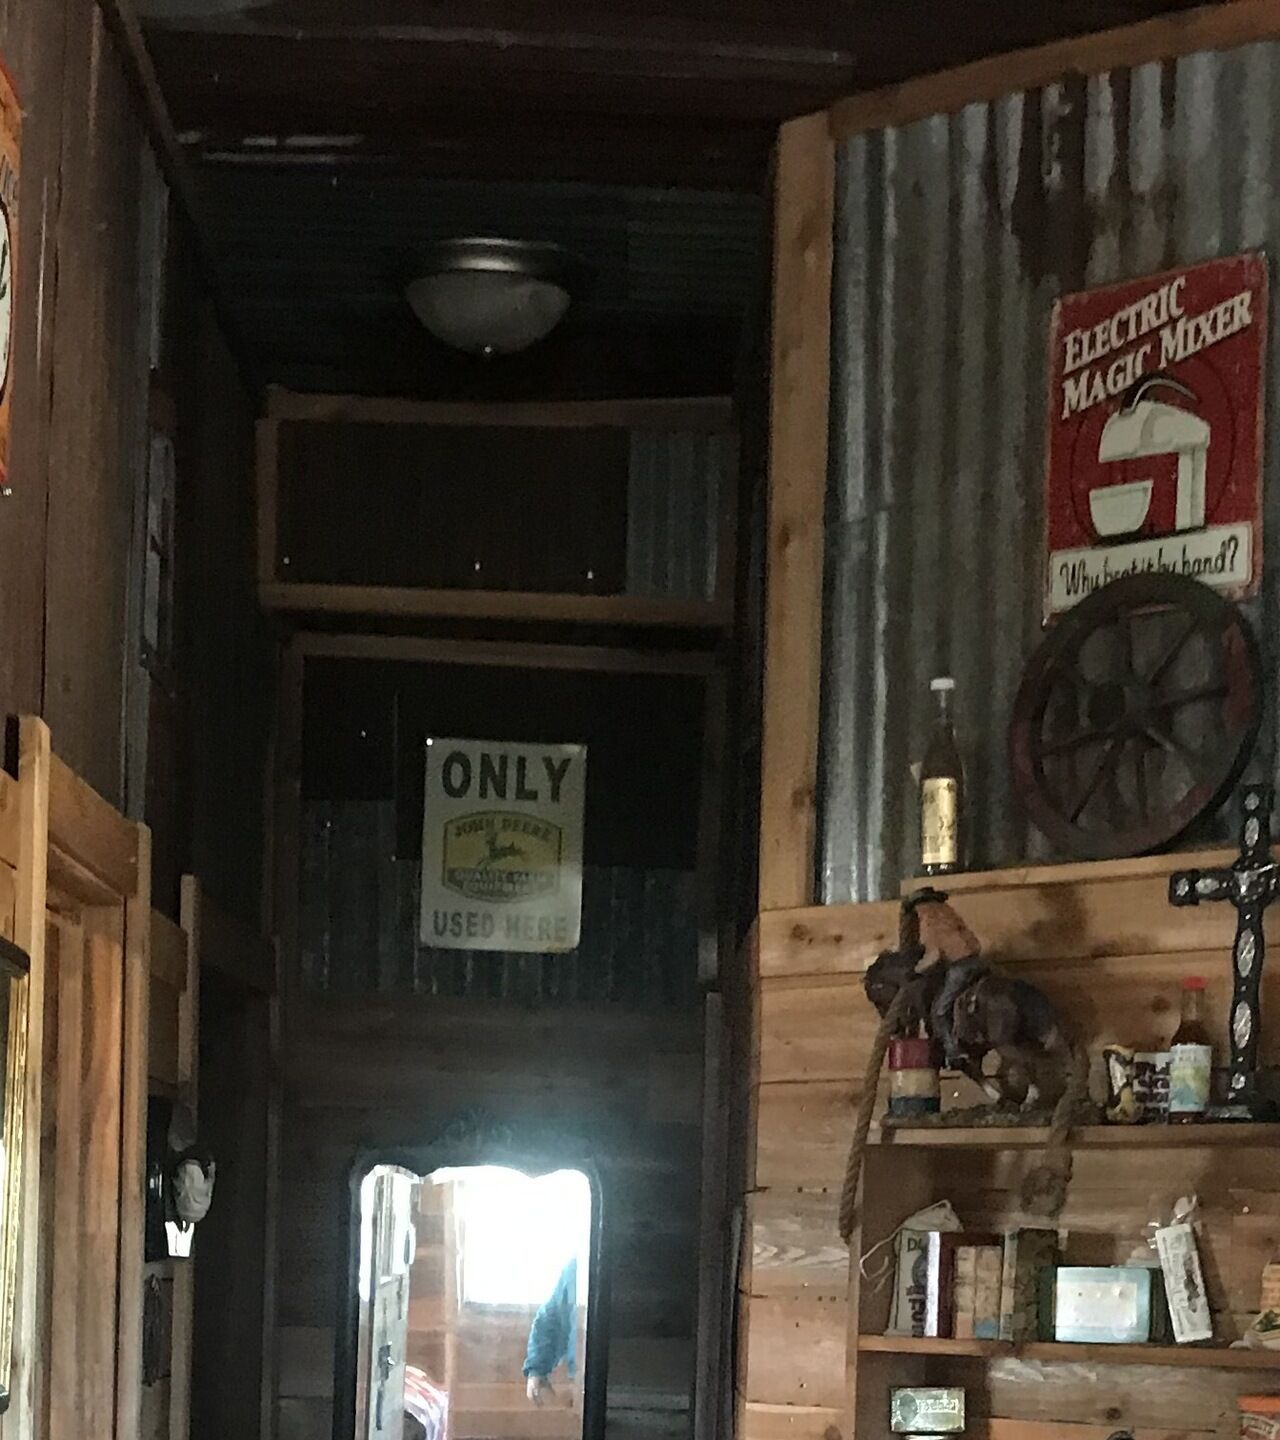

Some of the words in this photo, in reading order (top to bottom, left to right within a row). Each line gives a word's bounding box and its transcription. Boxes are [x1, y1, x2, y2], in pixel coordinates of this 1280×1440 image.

[1061, 345, 1154, 420] MAGIC
[1158, 290, 1254, 370] MIXER
[1062, 275, 1187, 375] ELECTRIC
[441, 750, 571, 803] ONLY
[433, 910, 495, 939] USED
[505, 913, 568, 943] HERE
